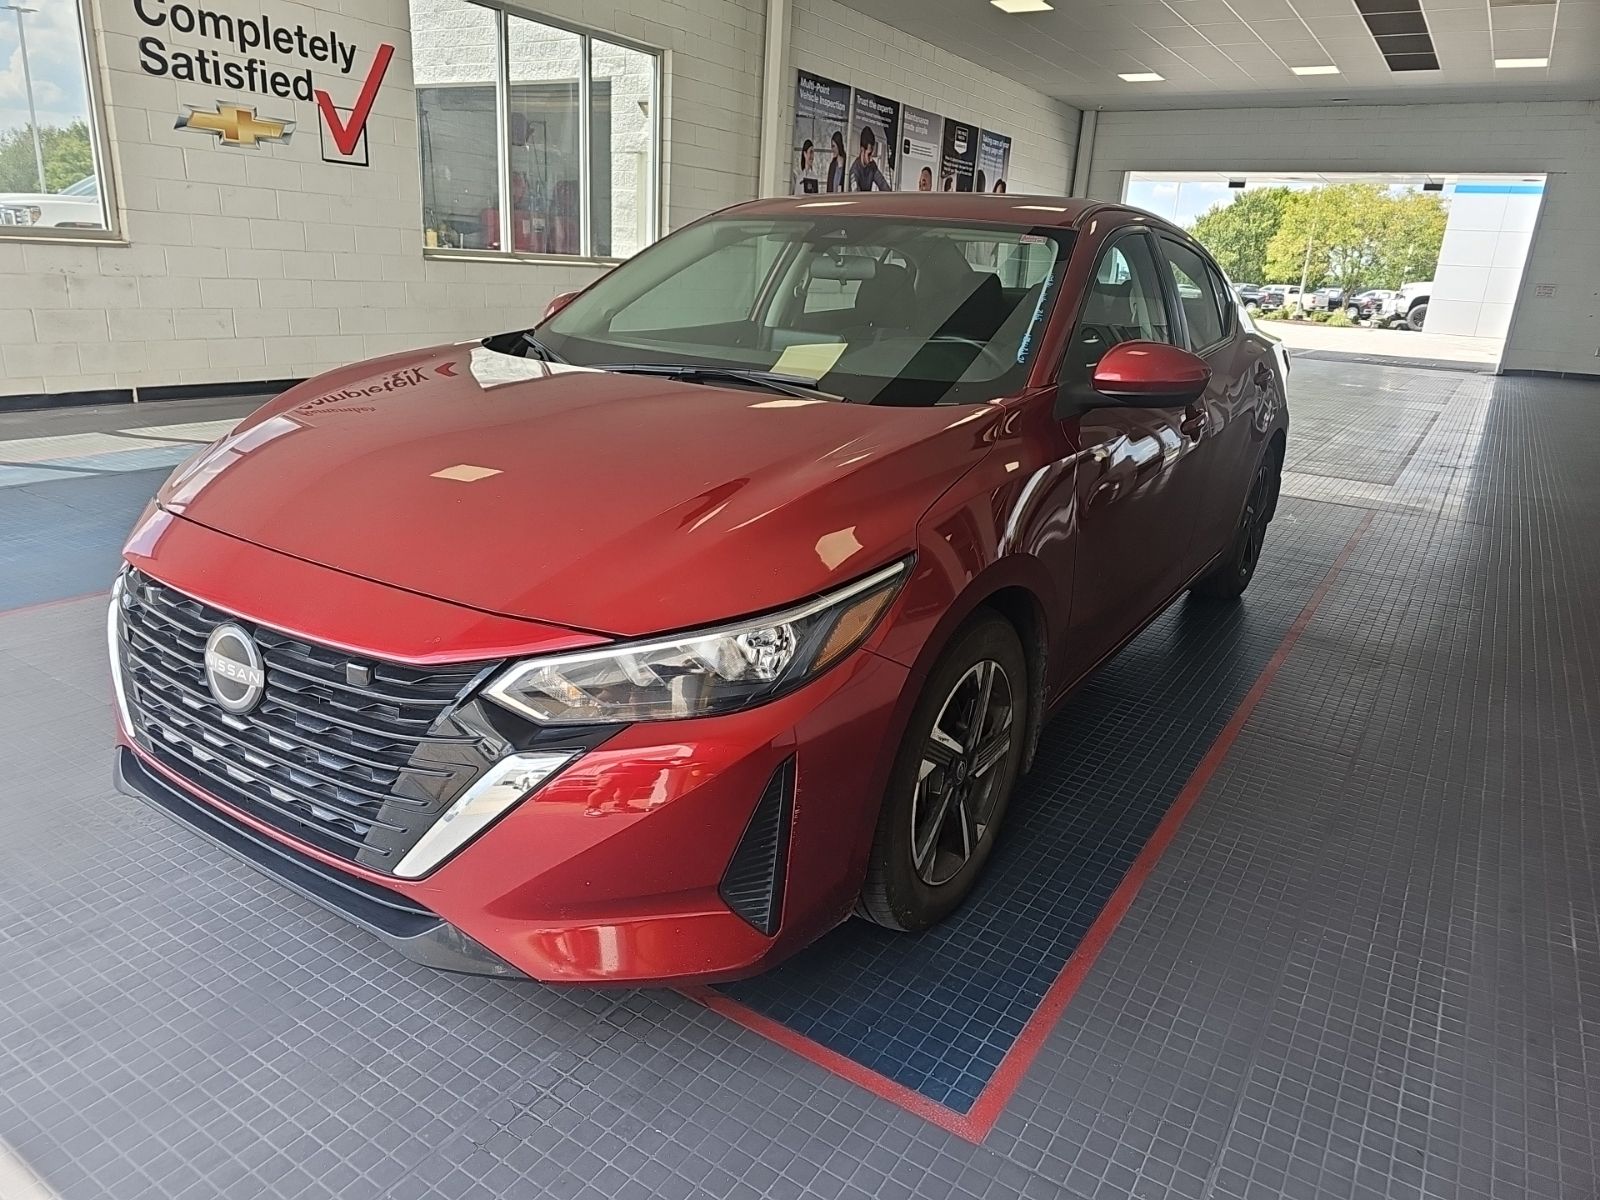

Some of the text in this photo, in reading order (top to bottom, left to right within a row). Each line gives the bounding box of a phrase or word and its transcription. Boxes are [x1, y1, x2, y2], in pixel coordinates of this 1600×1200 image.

[132, 0, 357, 73] Completely
[139, 36, 314, 102] Satisfied
[800, 77, 830, 95] Multi-Point
[799, 89, 846, 111] Vehicle Inspection
[856, 94, 893, 114] Trust the experts
[904, 111, 929, 126] Maintenance
[207, 651, 260, 684] NISSAN
